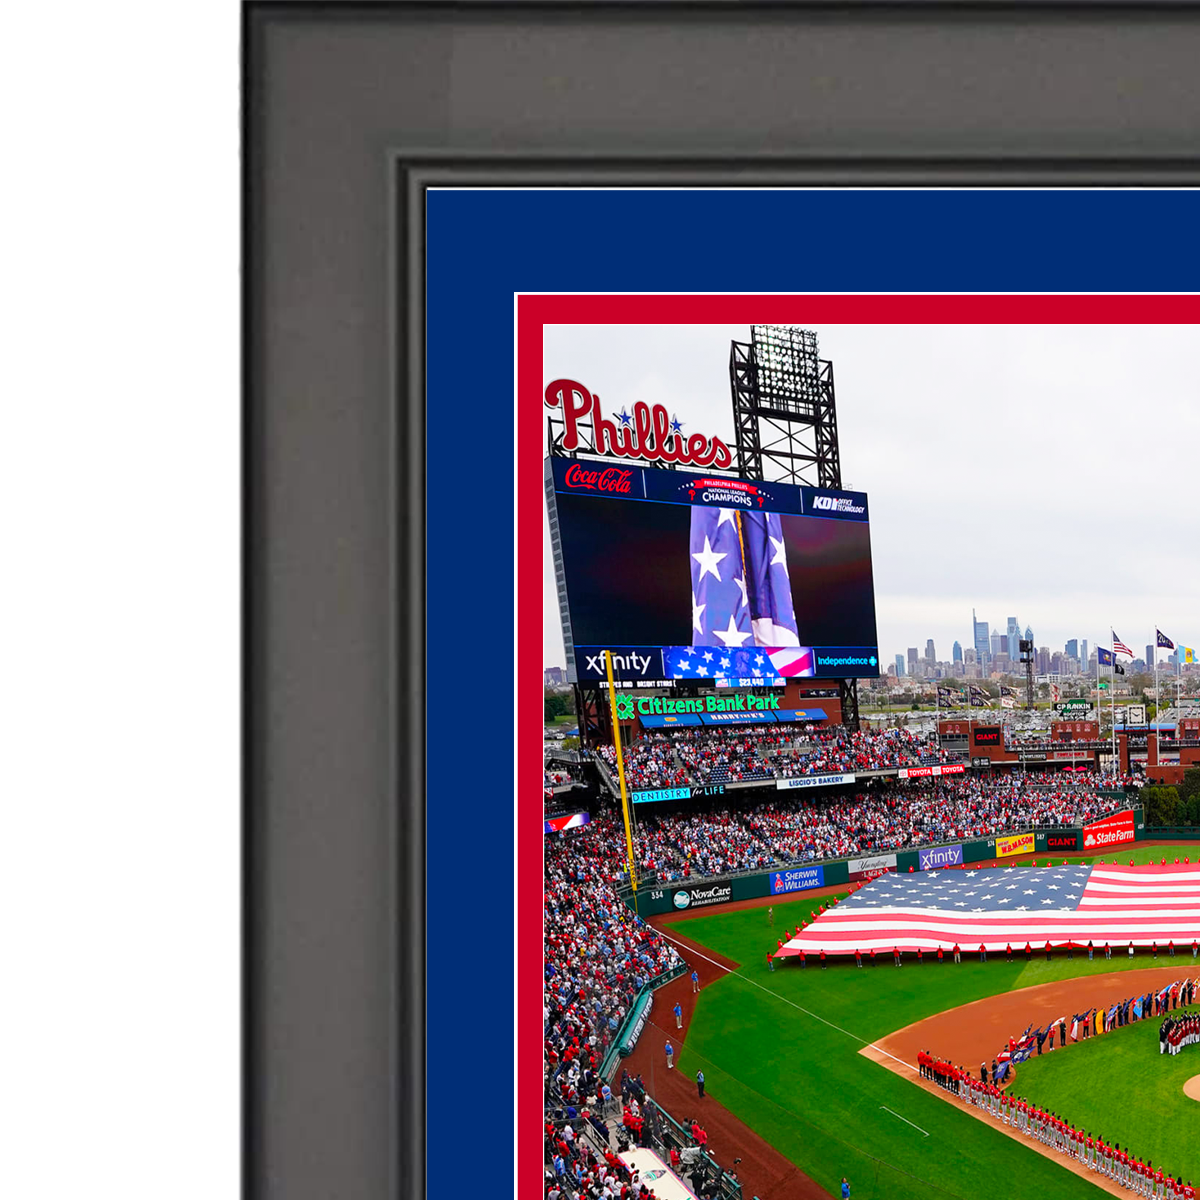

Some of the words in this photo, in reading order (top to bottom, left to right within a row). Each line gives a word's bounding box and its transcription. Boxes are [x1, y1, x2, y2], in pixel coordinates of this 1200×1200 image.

[545, 378, 733, 468] Phillies
[565, 463, 633, 494] Coca-Cola
[704, 480, 731, 488] PHILADELPHIA
[731, 482, 748, 490] PHILLIES
[702, 491, 752, 507] CHAMPIONS
[836, 503, 865, 514] TECHNOLOGY
[585, 650, 651, 675] xfnity
[817, 656, 868, 667] Independence
[637, 697, 704, 715] Citizens
[706, 694, 745, 712] Bank
[747, 693, 780, 710] Park
[976, 733, 998, 741] GIANT
[909, 768, 931, 776] TOYOTA
[942, 765, 964, 773] TOYOTA
[788, 777, 817, 787] LISCIO'S
[817, 775, 844, 784] BAKERY
[632, 788, 690, 802] DENTISTRY
[704, 785, 725, 796] LIFE
[1047, 837, 1077, 846] GIANT
[921, 848, 961, 868] xfinity
[784, 869, 818, 882] SHERWIN
[651, 890, 664, 900] 334
[690, 885, 731, 901] NovaCare
[691, 896, 731, 907] REHABILITATION
